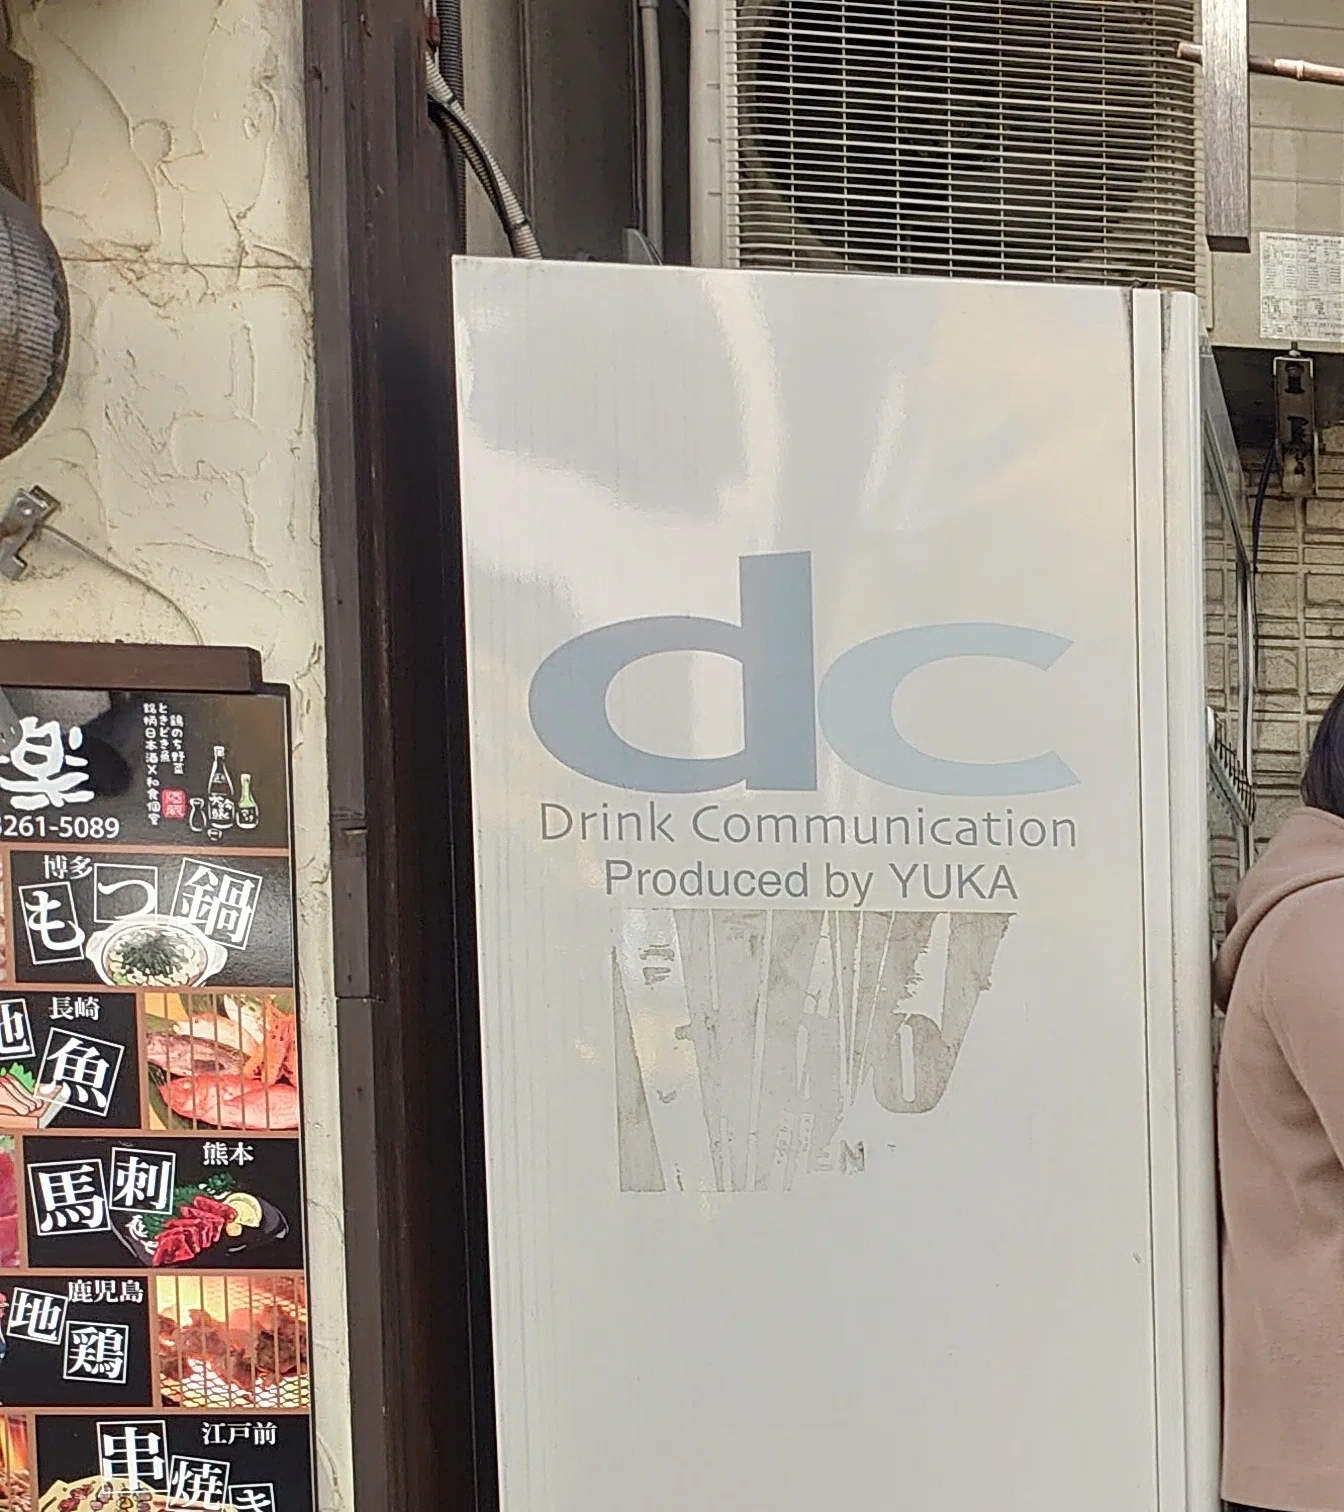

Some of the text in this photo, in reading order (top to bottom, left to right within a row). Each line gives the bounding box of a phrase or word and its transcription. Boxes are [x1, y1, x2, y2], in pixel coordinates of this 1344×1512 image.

[528, 551, 1081, 796] dc
[0, 815, 119, 838] 261-5089
[540, 802, 1077, 848] Drink Communication
[43, 855, 93, 880] 博多
[604, 860, 1018, 906] Produced by YUKA
[25, 864, 256, 951] もつ鍋
[49, 997, 100, 1021] 長崎
[203, 1141, 254, 1166] 熊本
[37, 1153, 172, 1231] 馬刺
[67, 1280, 144, 1304] 鹿児島
[11, 1293, 124, 1380] 地鶏
[202, 1422, 278, 1446] 江戸前
